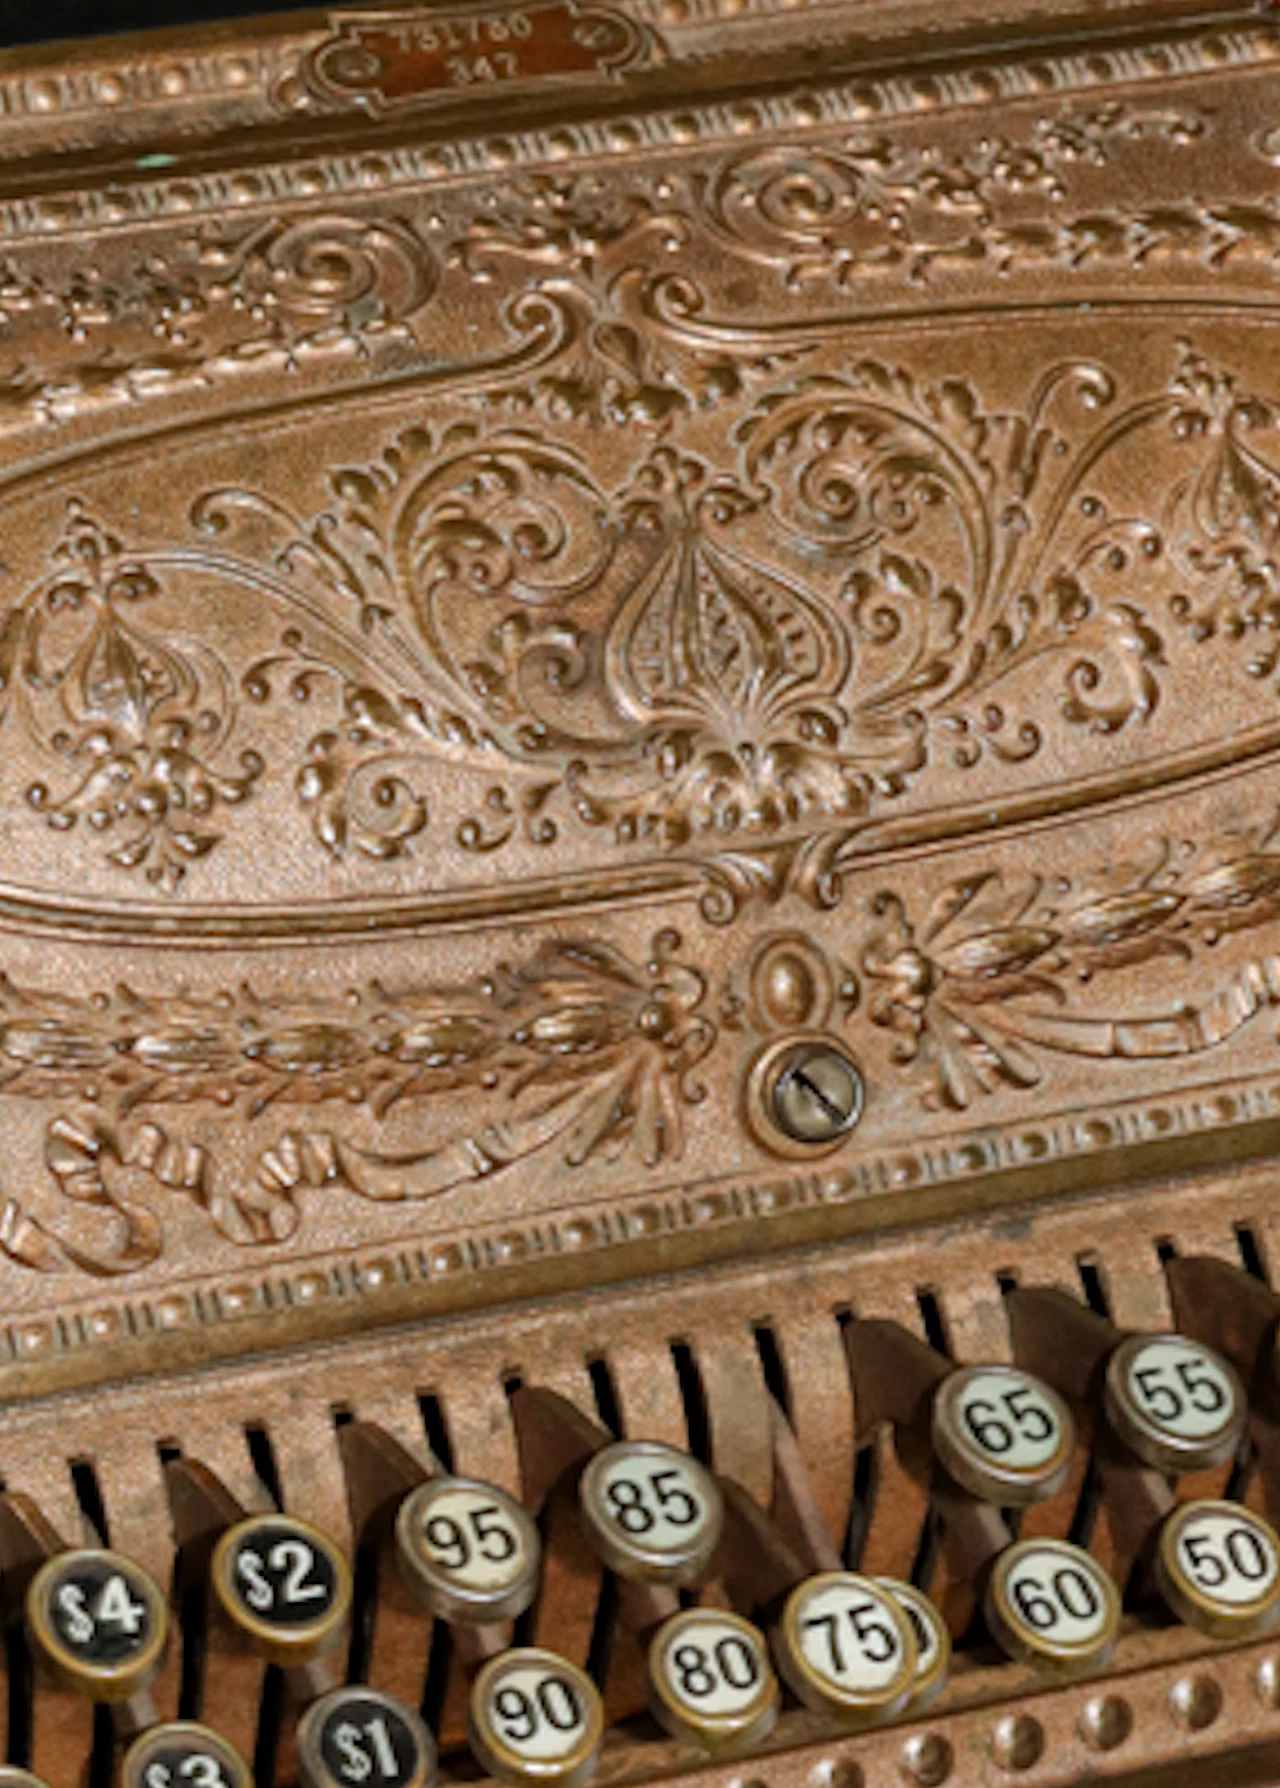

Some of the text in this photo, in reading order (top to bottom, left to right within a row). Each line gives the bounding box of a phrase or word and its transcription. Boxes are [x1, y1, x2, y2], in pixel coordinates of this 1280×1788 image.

[964, 1388, 1055, 1454] 65
[1133, 1358, 1227, 1421] 55
[606, 1469, 701, 1534] 85
[426, 1506, 517, 1569] 95
[1183, 1528, 1268, 1588] 50
[236, 1540, 327, 1611] $2
[1013, 1568, 1099, 1631] 60
[58, 1574, 145, 1644] $4
[803, 1604, 898, 1672] 75
[672, 1636, 759, 1698] 80
[492, 1675, 584, 1741] 90
[332, 1716, 399, 1783] $1
